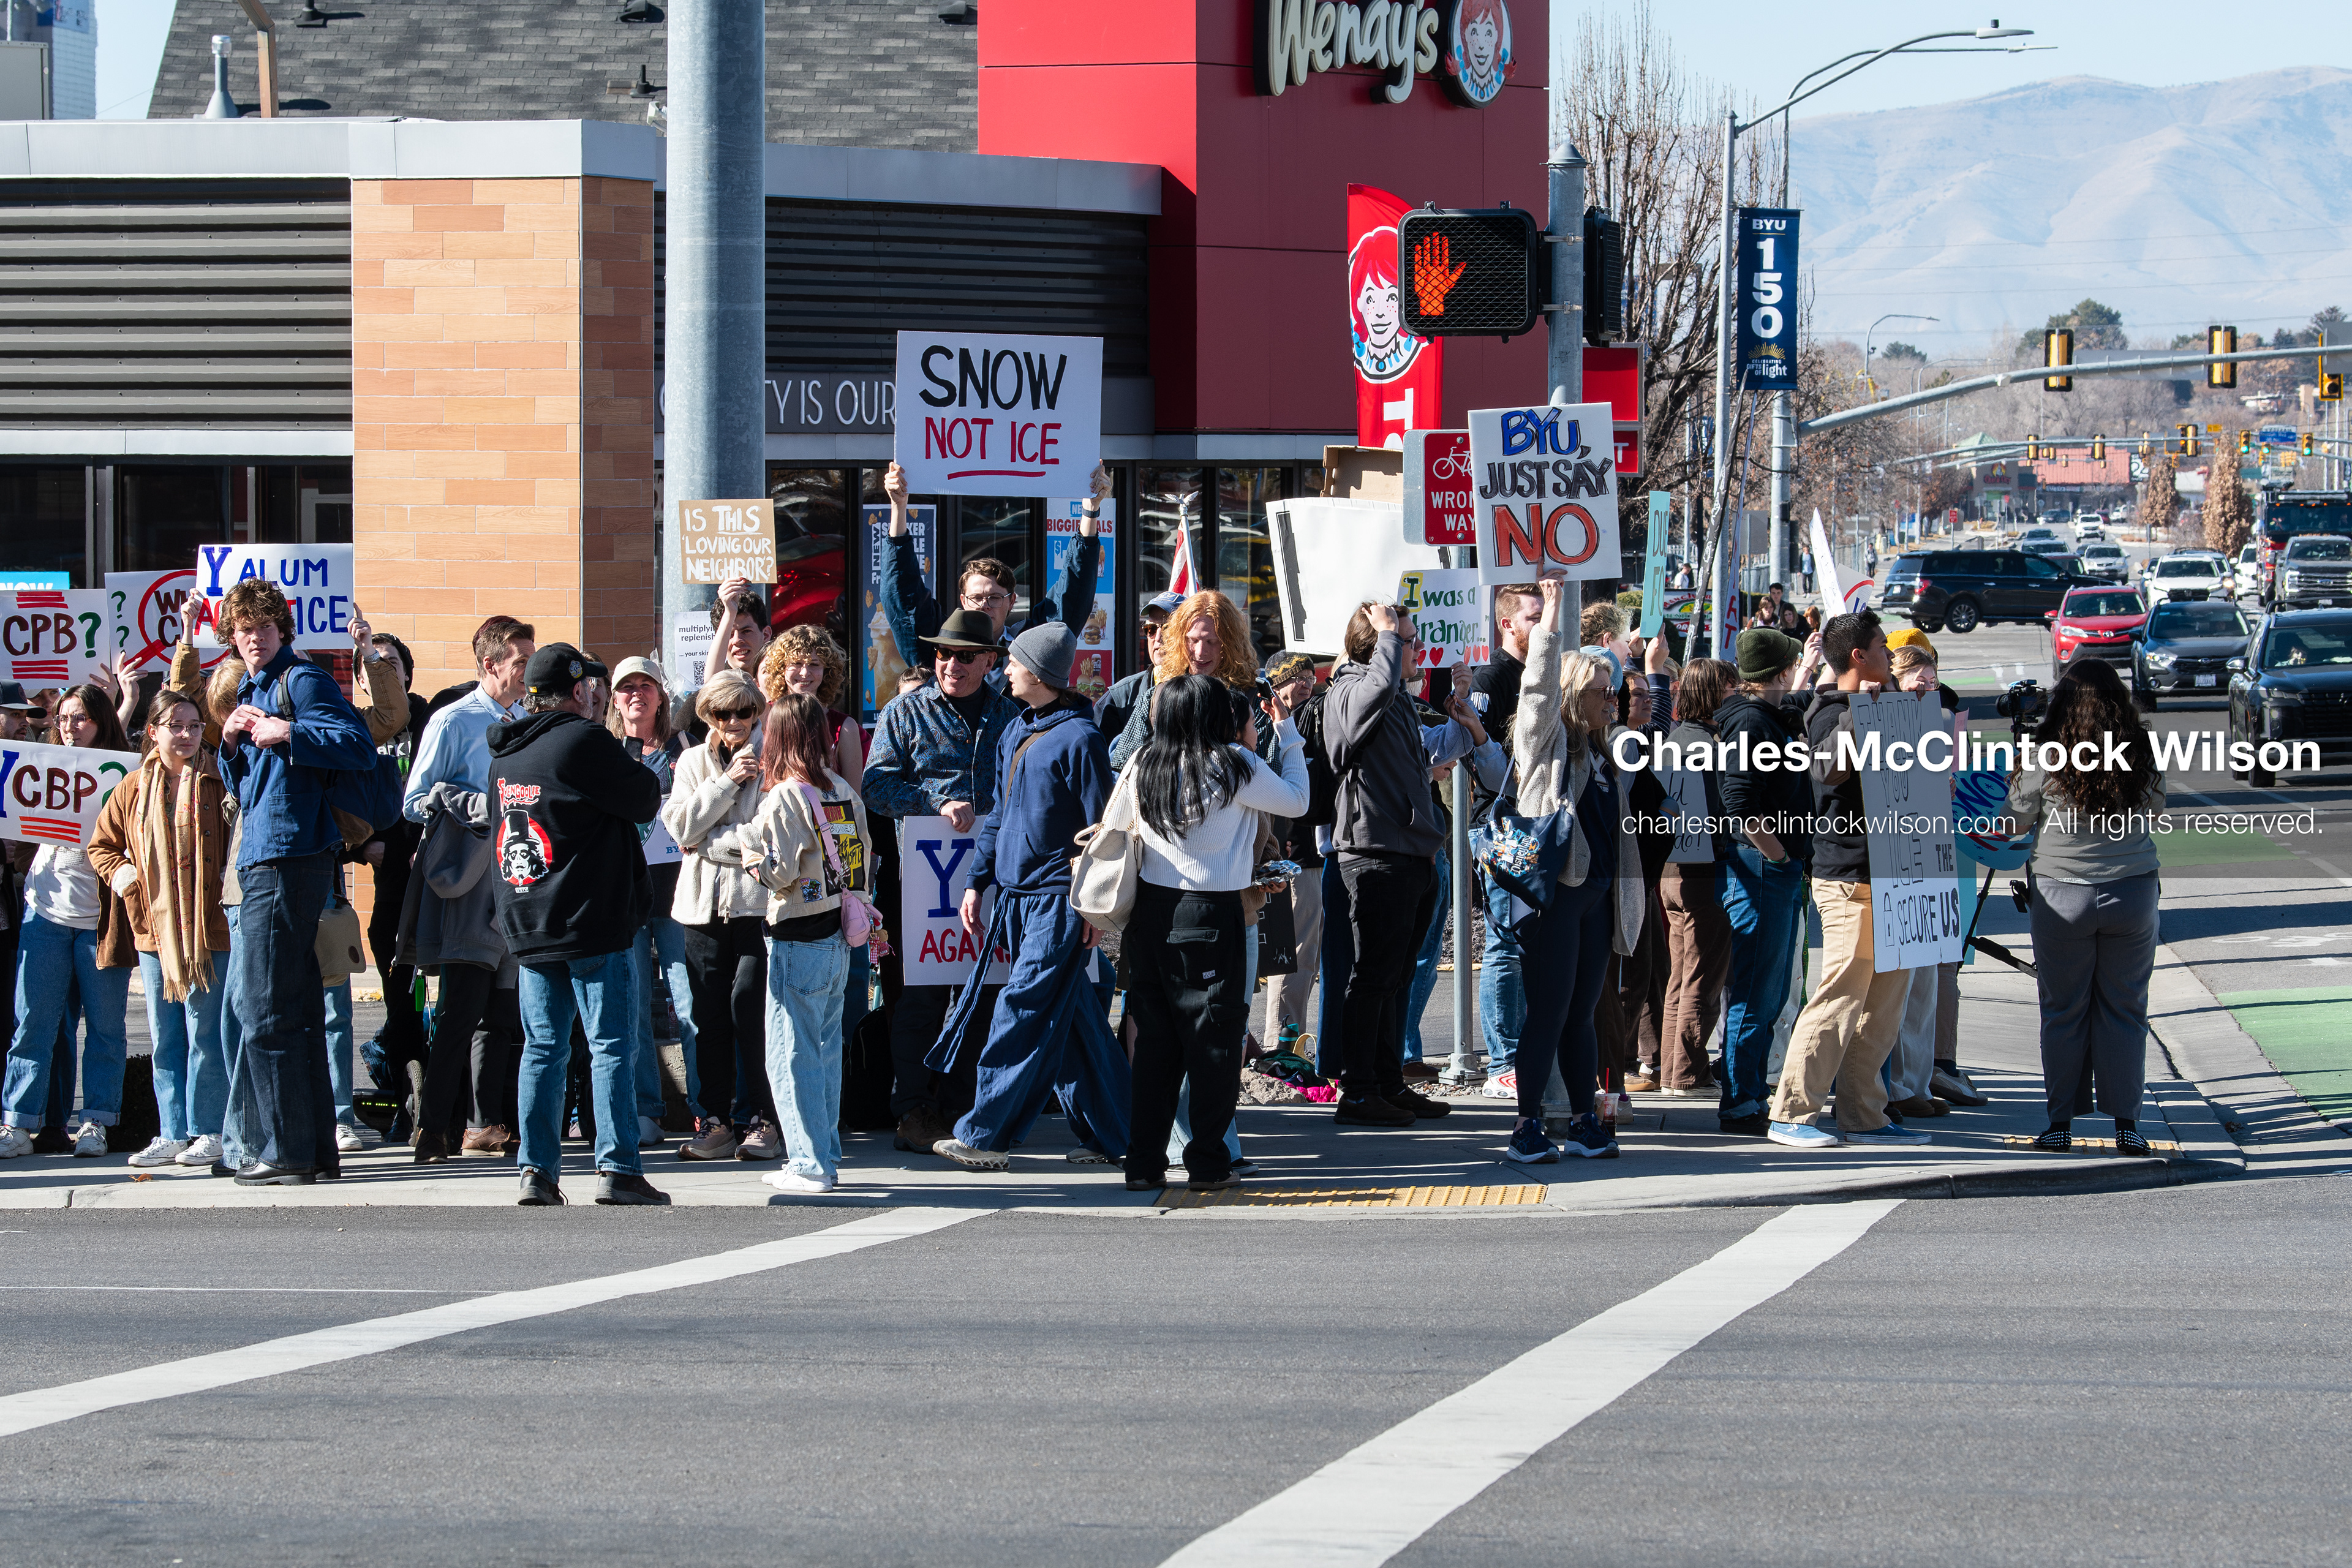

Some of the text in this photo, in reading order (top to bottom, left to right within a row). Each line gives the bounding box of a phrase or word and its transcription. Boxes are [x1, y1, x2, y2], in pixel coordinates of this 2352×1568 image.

[1752, 219, 1786, 230] BYU
[919, 345, 1067, 410] SNOW
[1762, 363, 1787, 379] light
[800, 380, 823, 424] IS
[835, 380, 895, 424] OUR
[925, 417, 1062, 464] NOT ICE
[1501, 407, 1591, 459] BYU,
[1479, 457, 1613, 499] JUST SAY
[685, 505, 762, 532] IS THIS
[1444, 514, 1476, 531] WAY
[1491, 502, 1600, 567] NO
[743, 537, 772, 555] OUR
[201, 546, 328, 597] Y ALUM
[296, 595, 349, 635] ICE
[1423, 590, 1464, 607] was
[1468, 586, 1476, 605] a
[3, 612, 102, 658] CPB?
[679, 624, 715, 633] multiplyi
[665, 845, 680, 854] BY
[1936, 843, 1954, 872] THE
[916, 838, 976, 918] Y
[1898, 894, 1938, 946] SECURE
